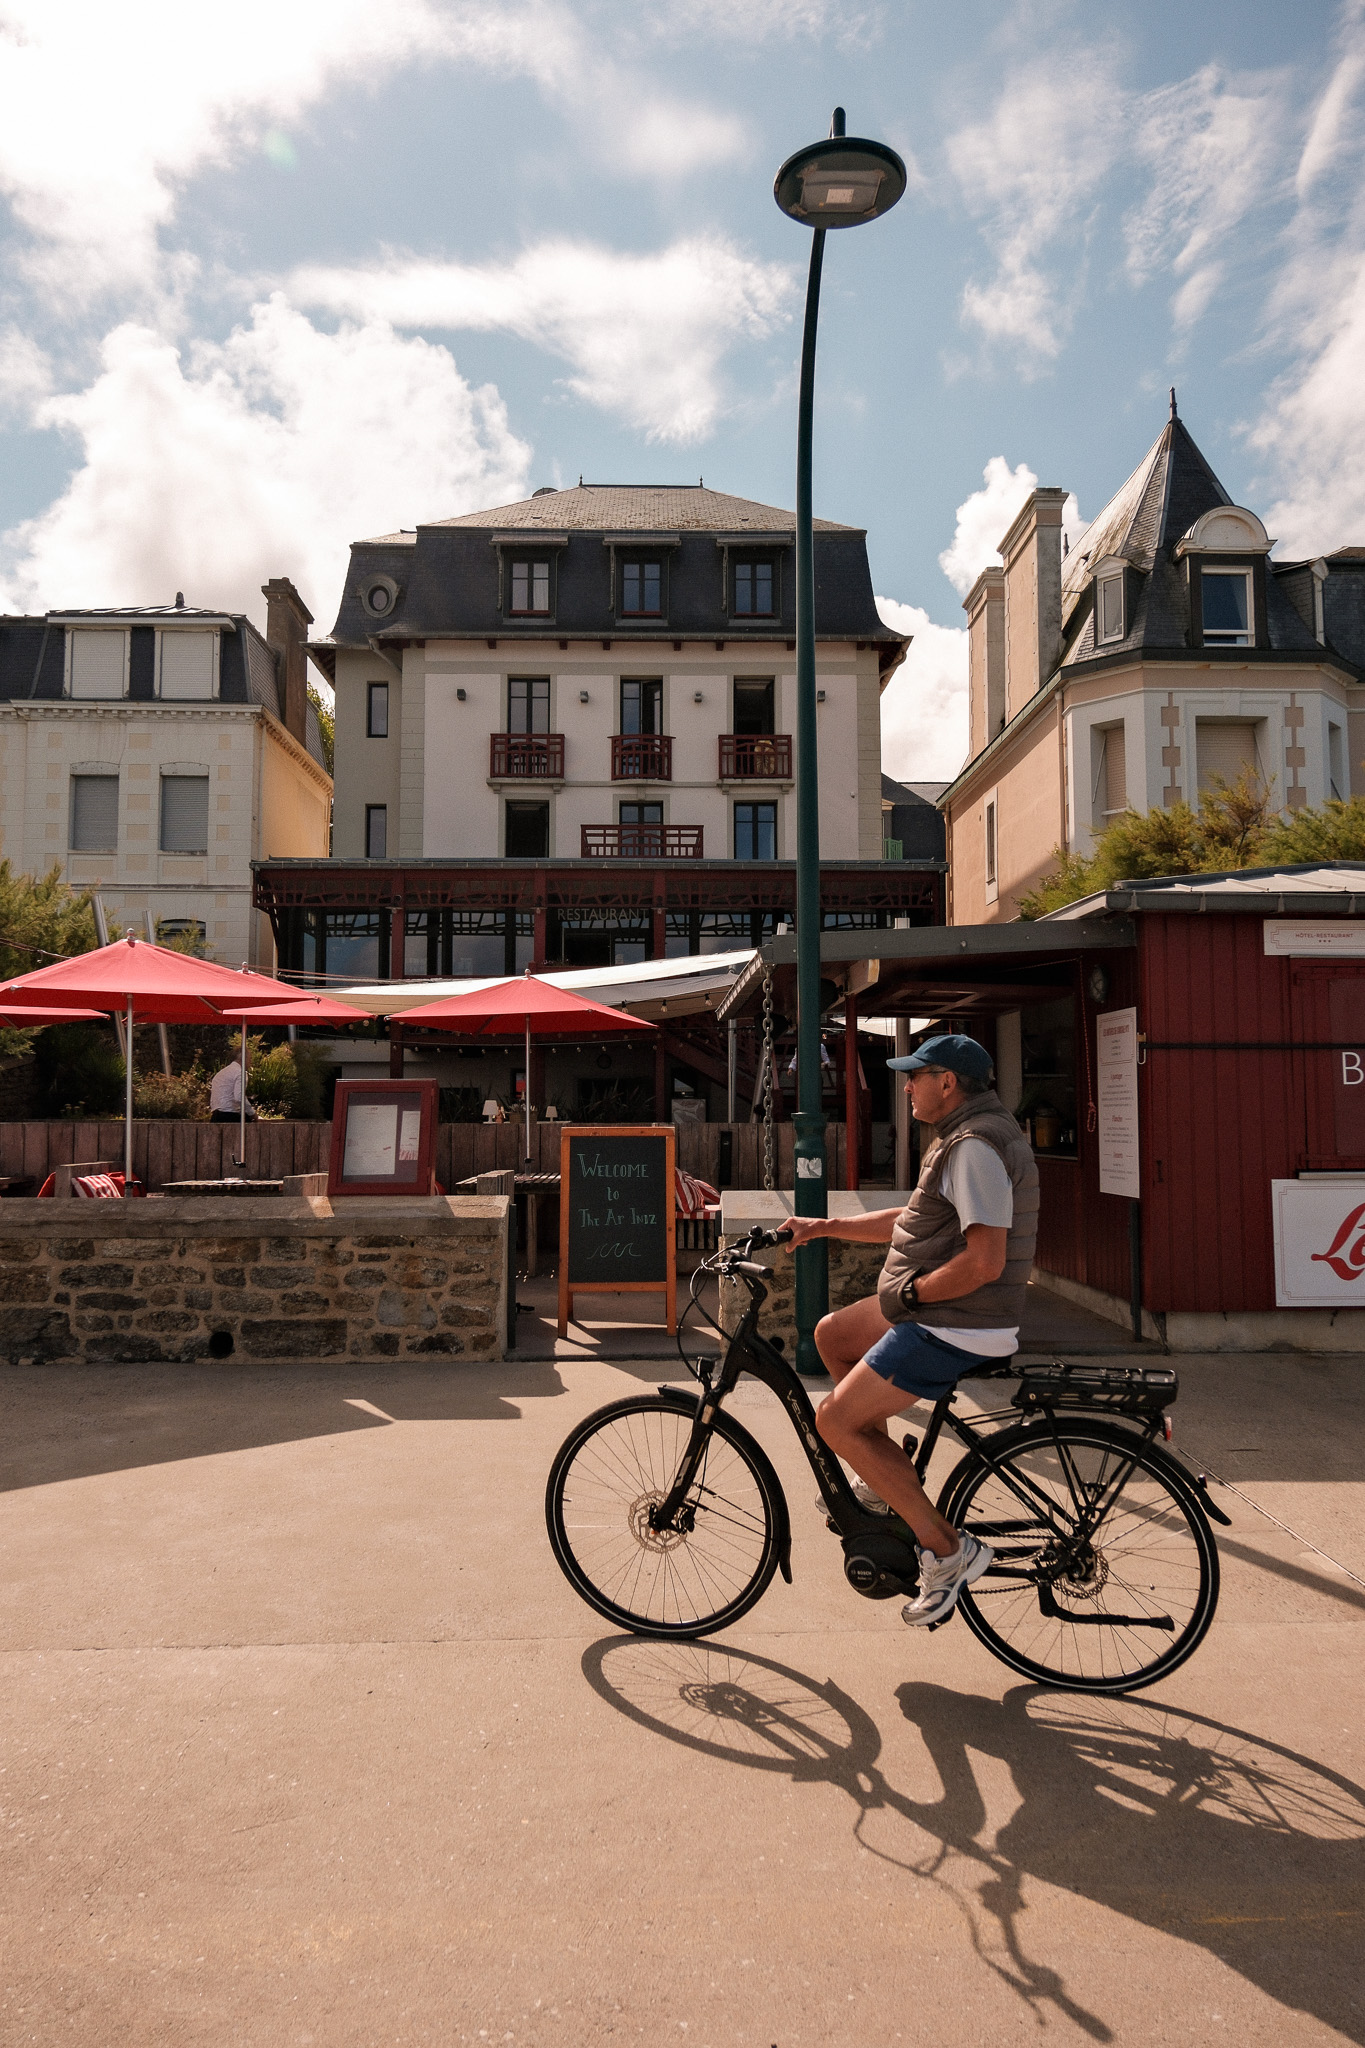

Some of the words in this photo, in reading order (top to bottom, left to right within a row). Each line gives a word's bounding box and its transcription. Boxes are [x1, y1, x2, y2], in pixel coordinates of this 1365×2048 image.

[557, 908, 649, 921] RESTAURANT
[577, 1153, 649, 1178] WELCOME
[607, 1186, 620, 1201] to
[604, 1208, 625, 1226] Ar
